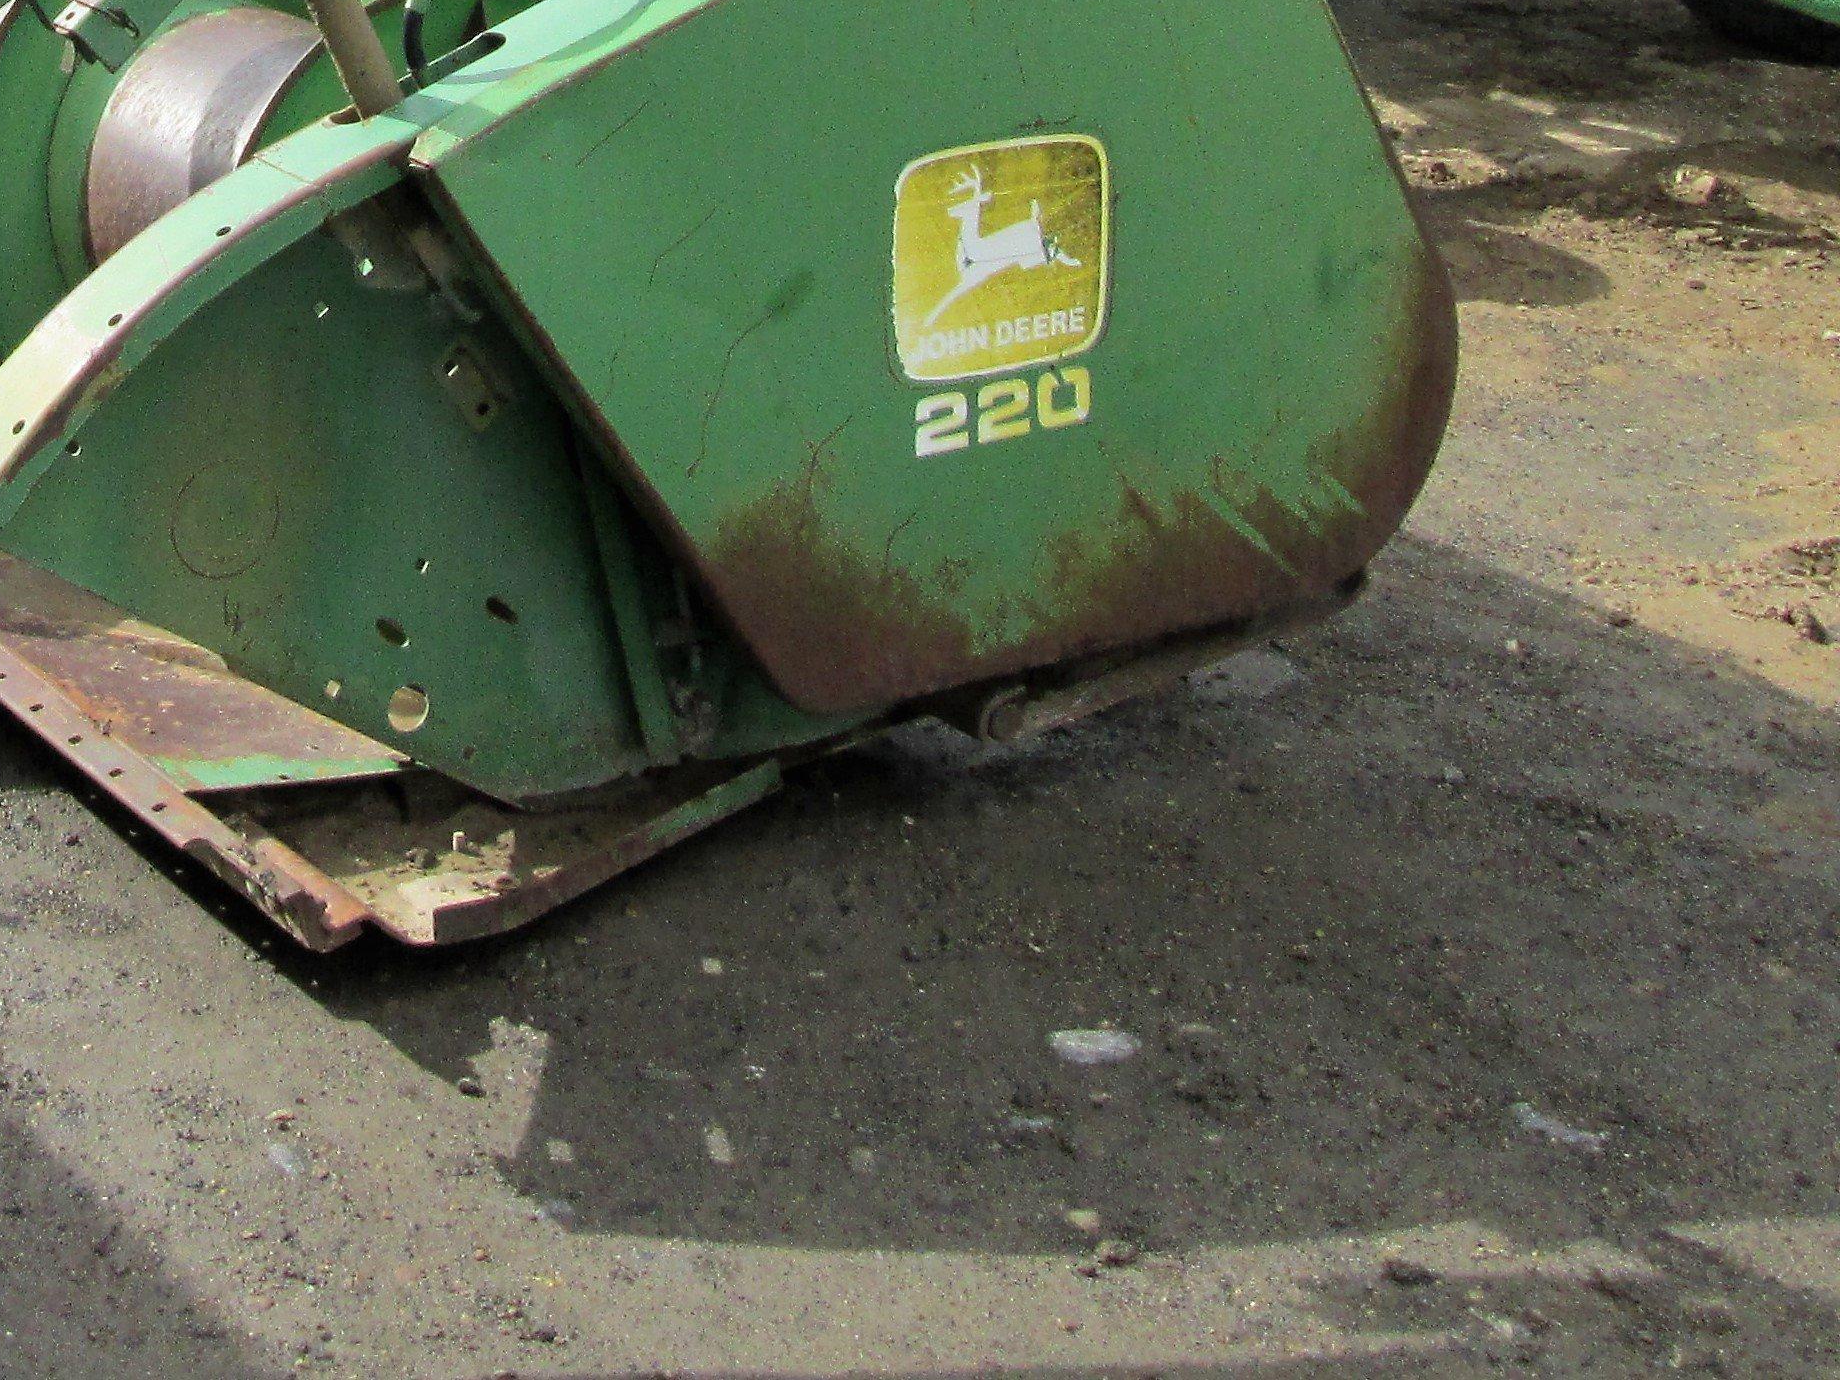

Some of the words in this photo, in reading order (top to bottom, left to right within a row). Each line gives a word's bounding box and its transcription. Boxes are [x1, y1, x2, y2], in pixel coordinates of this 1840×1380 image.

[913, 325, 989, 362] JOHN
[995, 306, 1086, 347] DEERE
[914, 366, 1091, 458] 220
